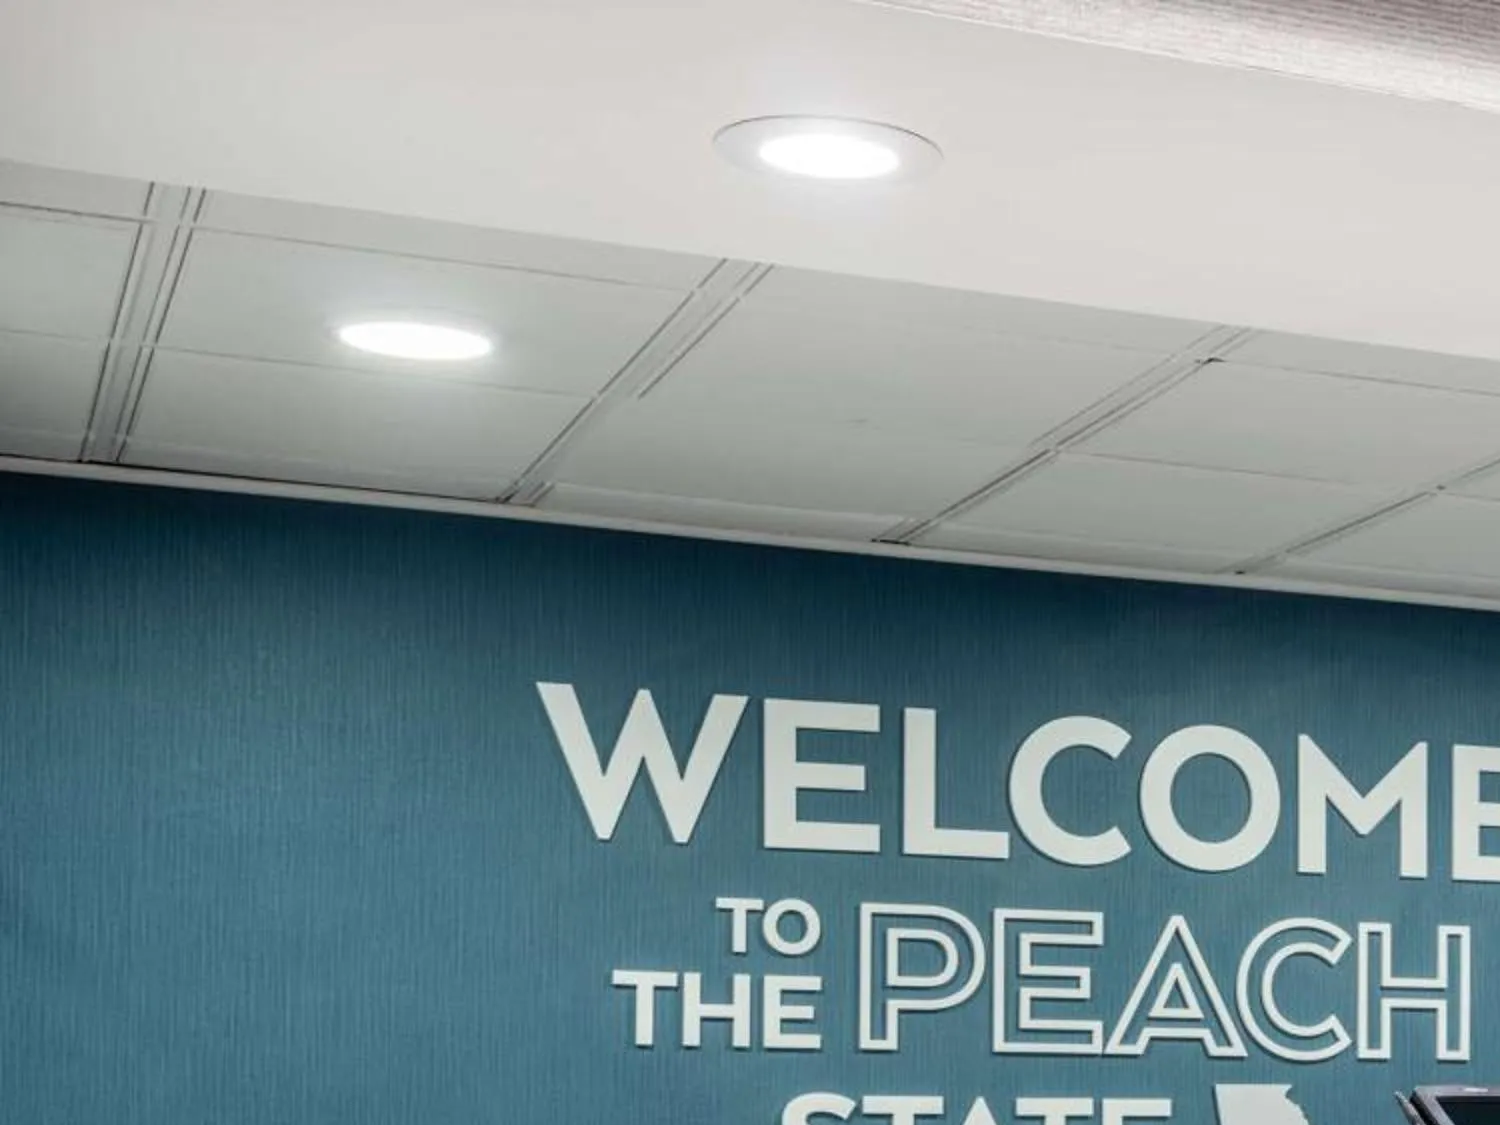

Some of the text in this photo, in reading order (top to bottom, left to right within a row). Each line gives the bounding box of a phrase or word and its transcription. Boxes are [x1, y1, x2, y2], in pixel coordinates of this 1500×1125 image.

[715, 896, 821, 955] TO
[611, 901, 1472, 1062] THE PEACH
